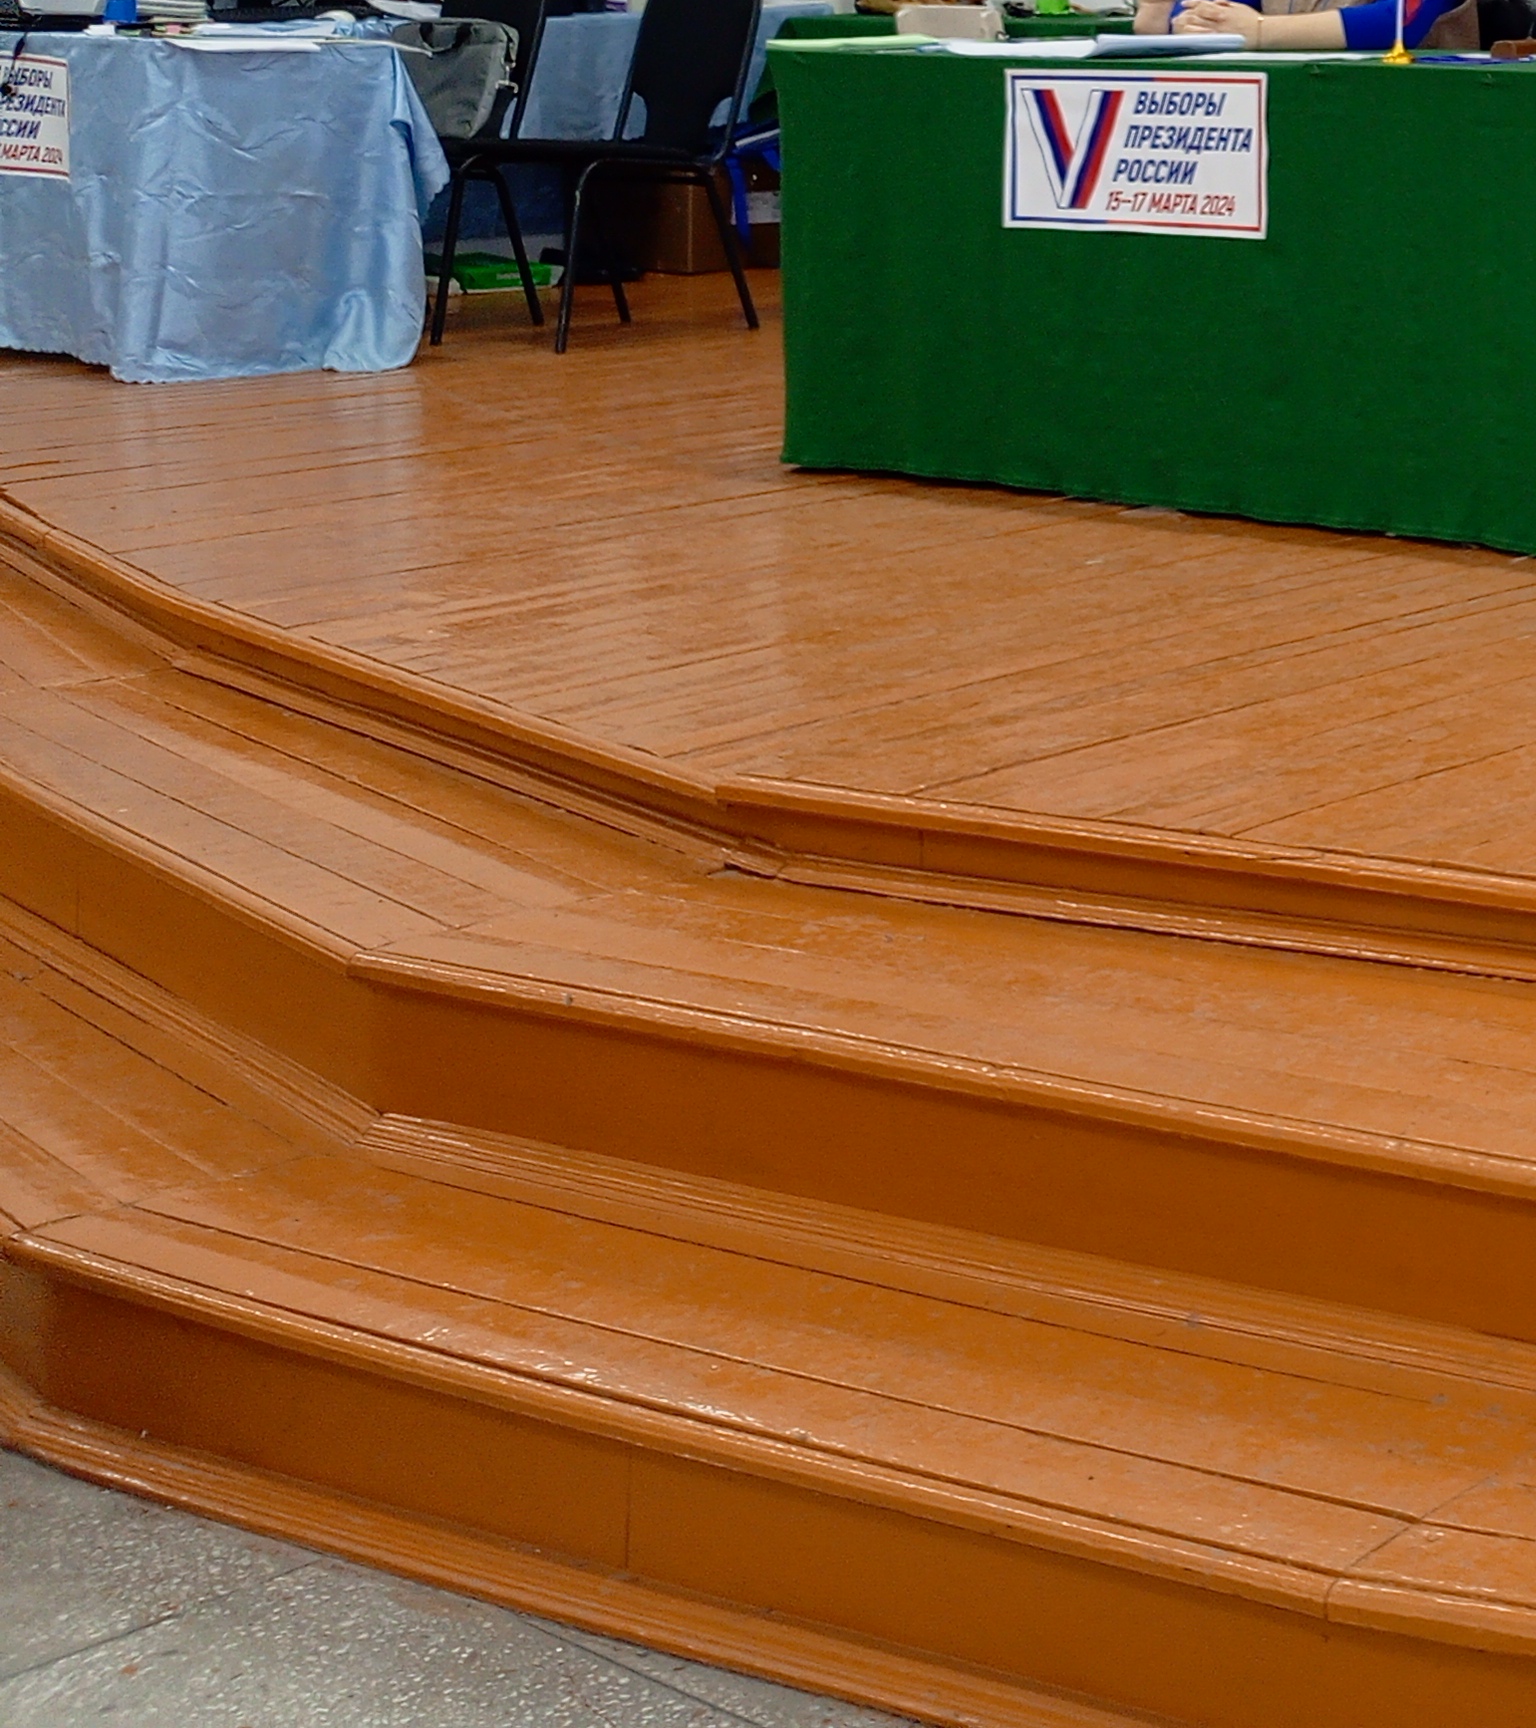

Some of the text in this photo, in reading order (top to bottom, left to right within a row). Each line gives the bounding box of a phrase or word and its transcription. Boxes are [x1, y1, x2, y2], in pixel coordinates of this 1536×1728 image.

[1133, 90, 1227, 117] ВЫБОРЫ
[1123, 124, 1253, 155] ПРЕЗИДЕНТА
[1112, 158, 1198, 185] РОССИИ
[1147, 192, 1199, 215] МАРТА
[1199, 194, 1236, 217] 2024
